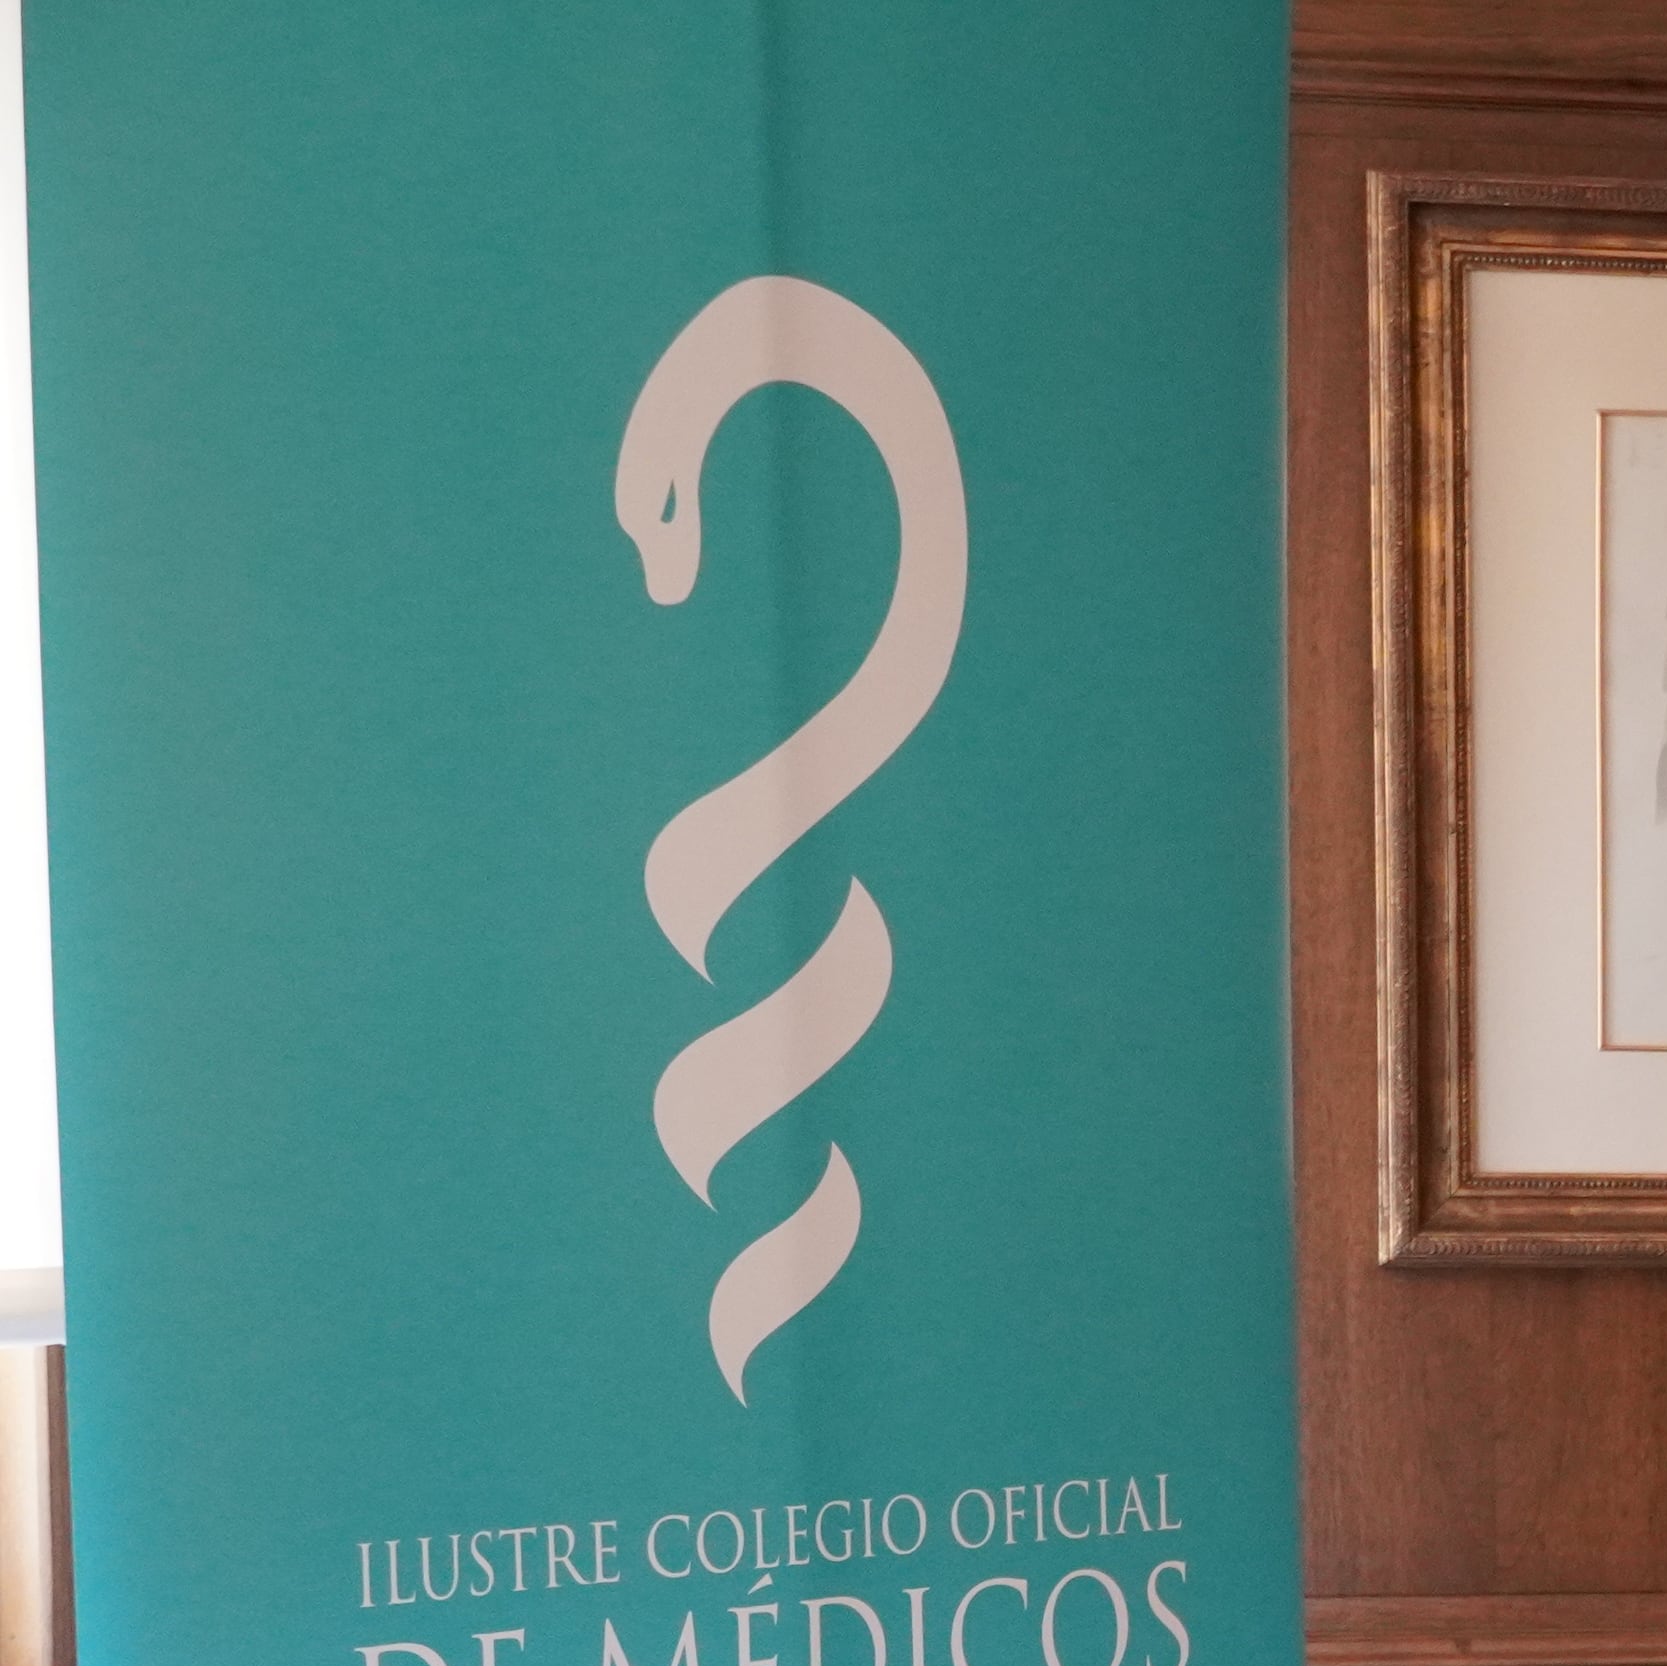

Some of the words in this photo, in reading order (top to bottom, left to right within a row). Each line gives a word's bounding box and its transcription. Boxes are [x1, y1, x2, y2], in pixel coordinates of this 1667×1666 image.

[357, 1520, 620, 1608] ILUSTRE
[646, 1494, 927, 1578] COLEGIO
[950, 1474, 1182, 1549] OFICIAL
